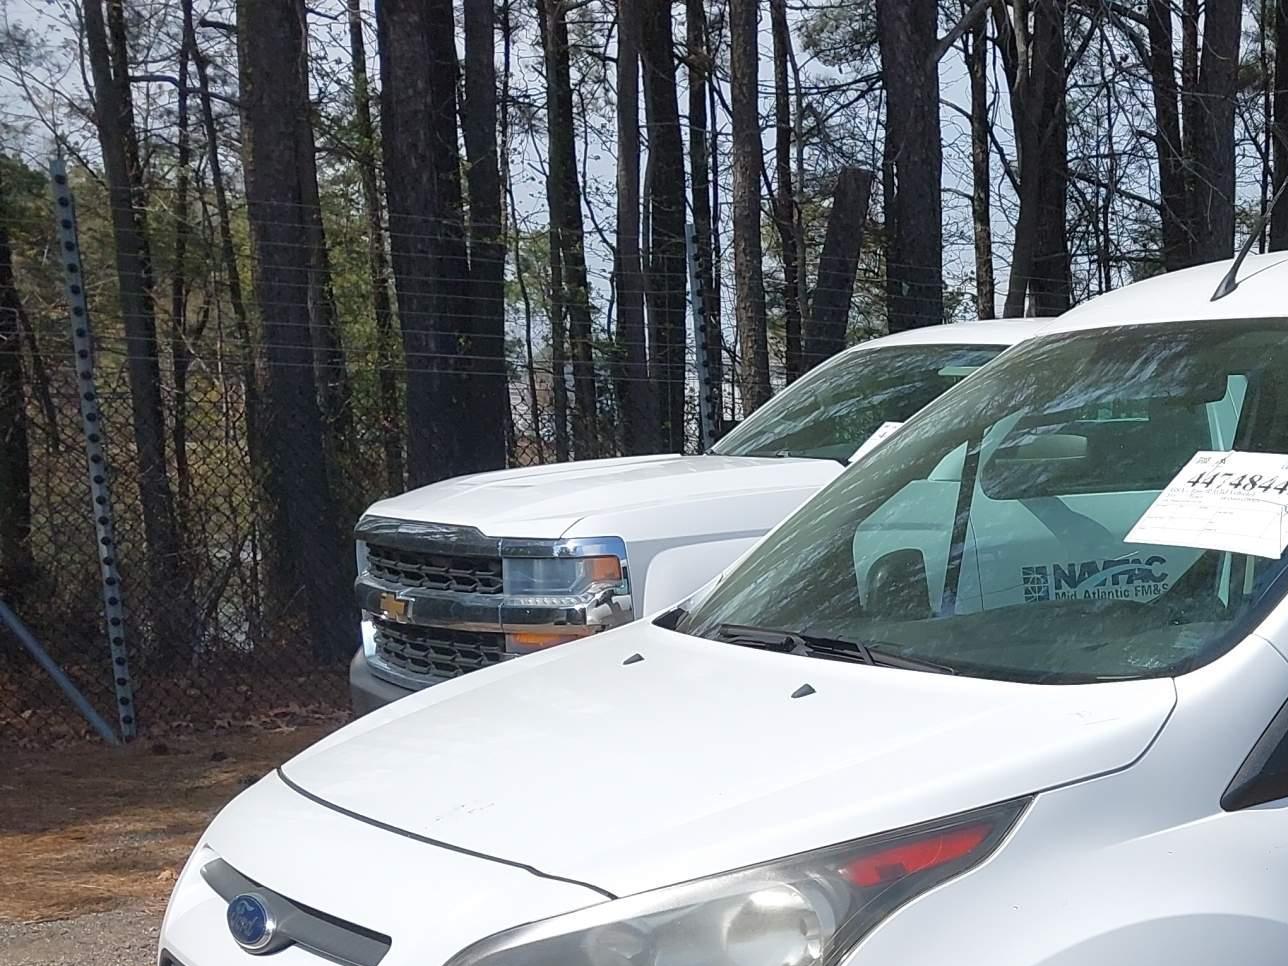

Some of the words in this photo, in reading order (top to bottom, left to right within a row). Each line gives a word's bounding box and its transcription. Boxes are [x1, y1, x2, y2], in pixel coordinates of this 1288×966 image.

[1055, 590, 1077, 600] Mid
[1084, 586, 1130, 600] Atlantic
[1134, 583, 1169, 597] FM&S
